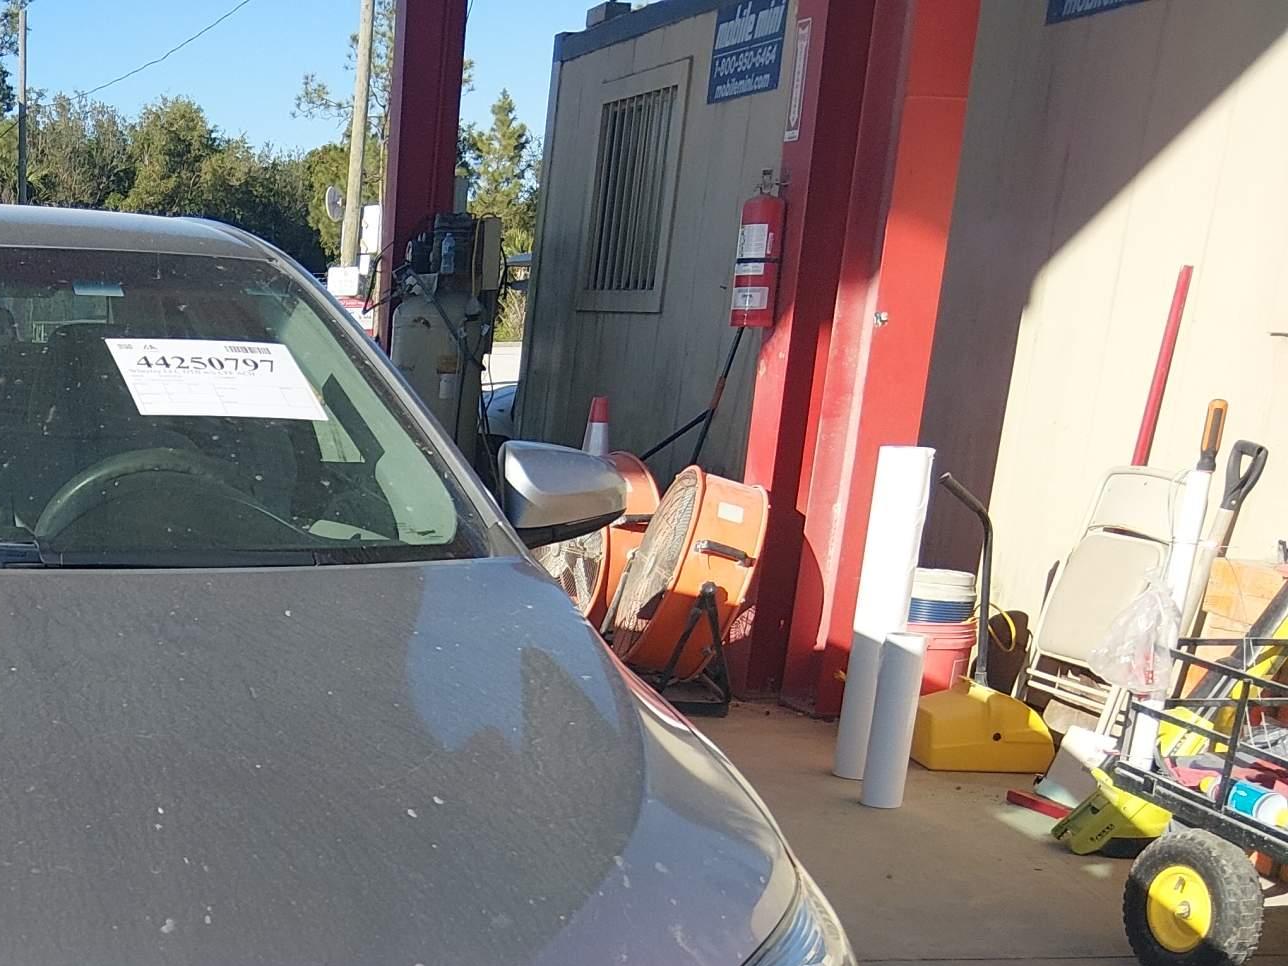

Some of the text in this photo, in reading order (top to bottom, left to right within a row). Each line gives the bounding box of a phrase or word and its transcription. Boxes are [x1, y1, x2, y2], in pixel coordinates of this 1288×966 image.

[715, 0, 786, 49] mobile mini
[714, 46, 777, 79] 1-800-950-6464
[715, 73, 770, 99] mobilemini.com
[136, 355, 274, 373] 44250797
